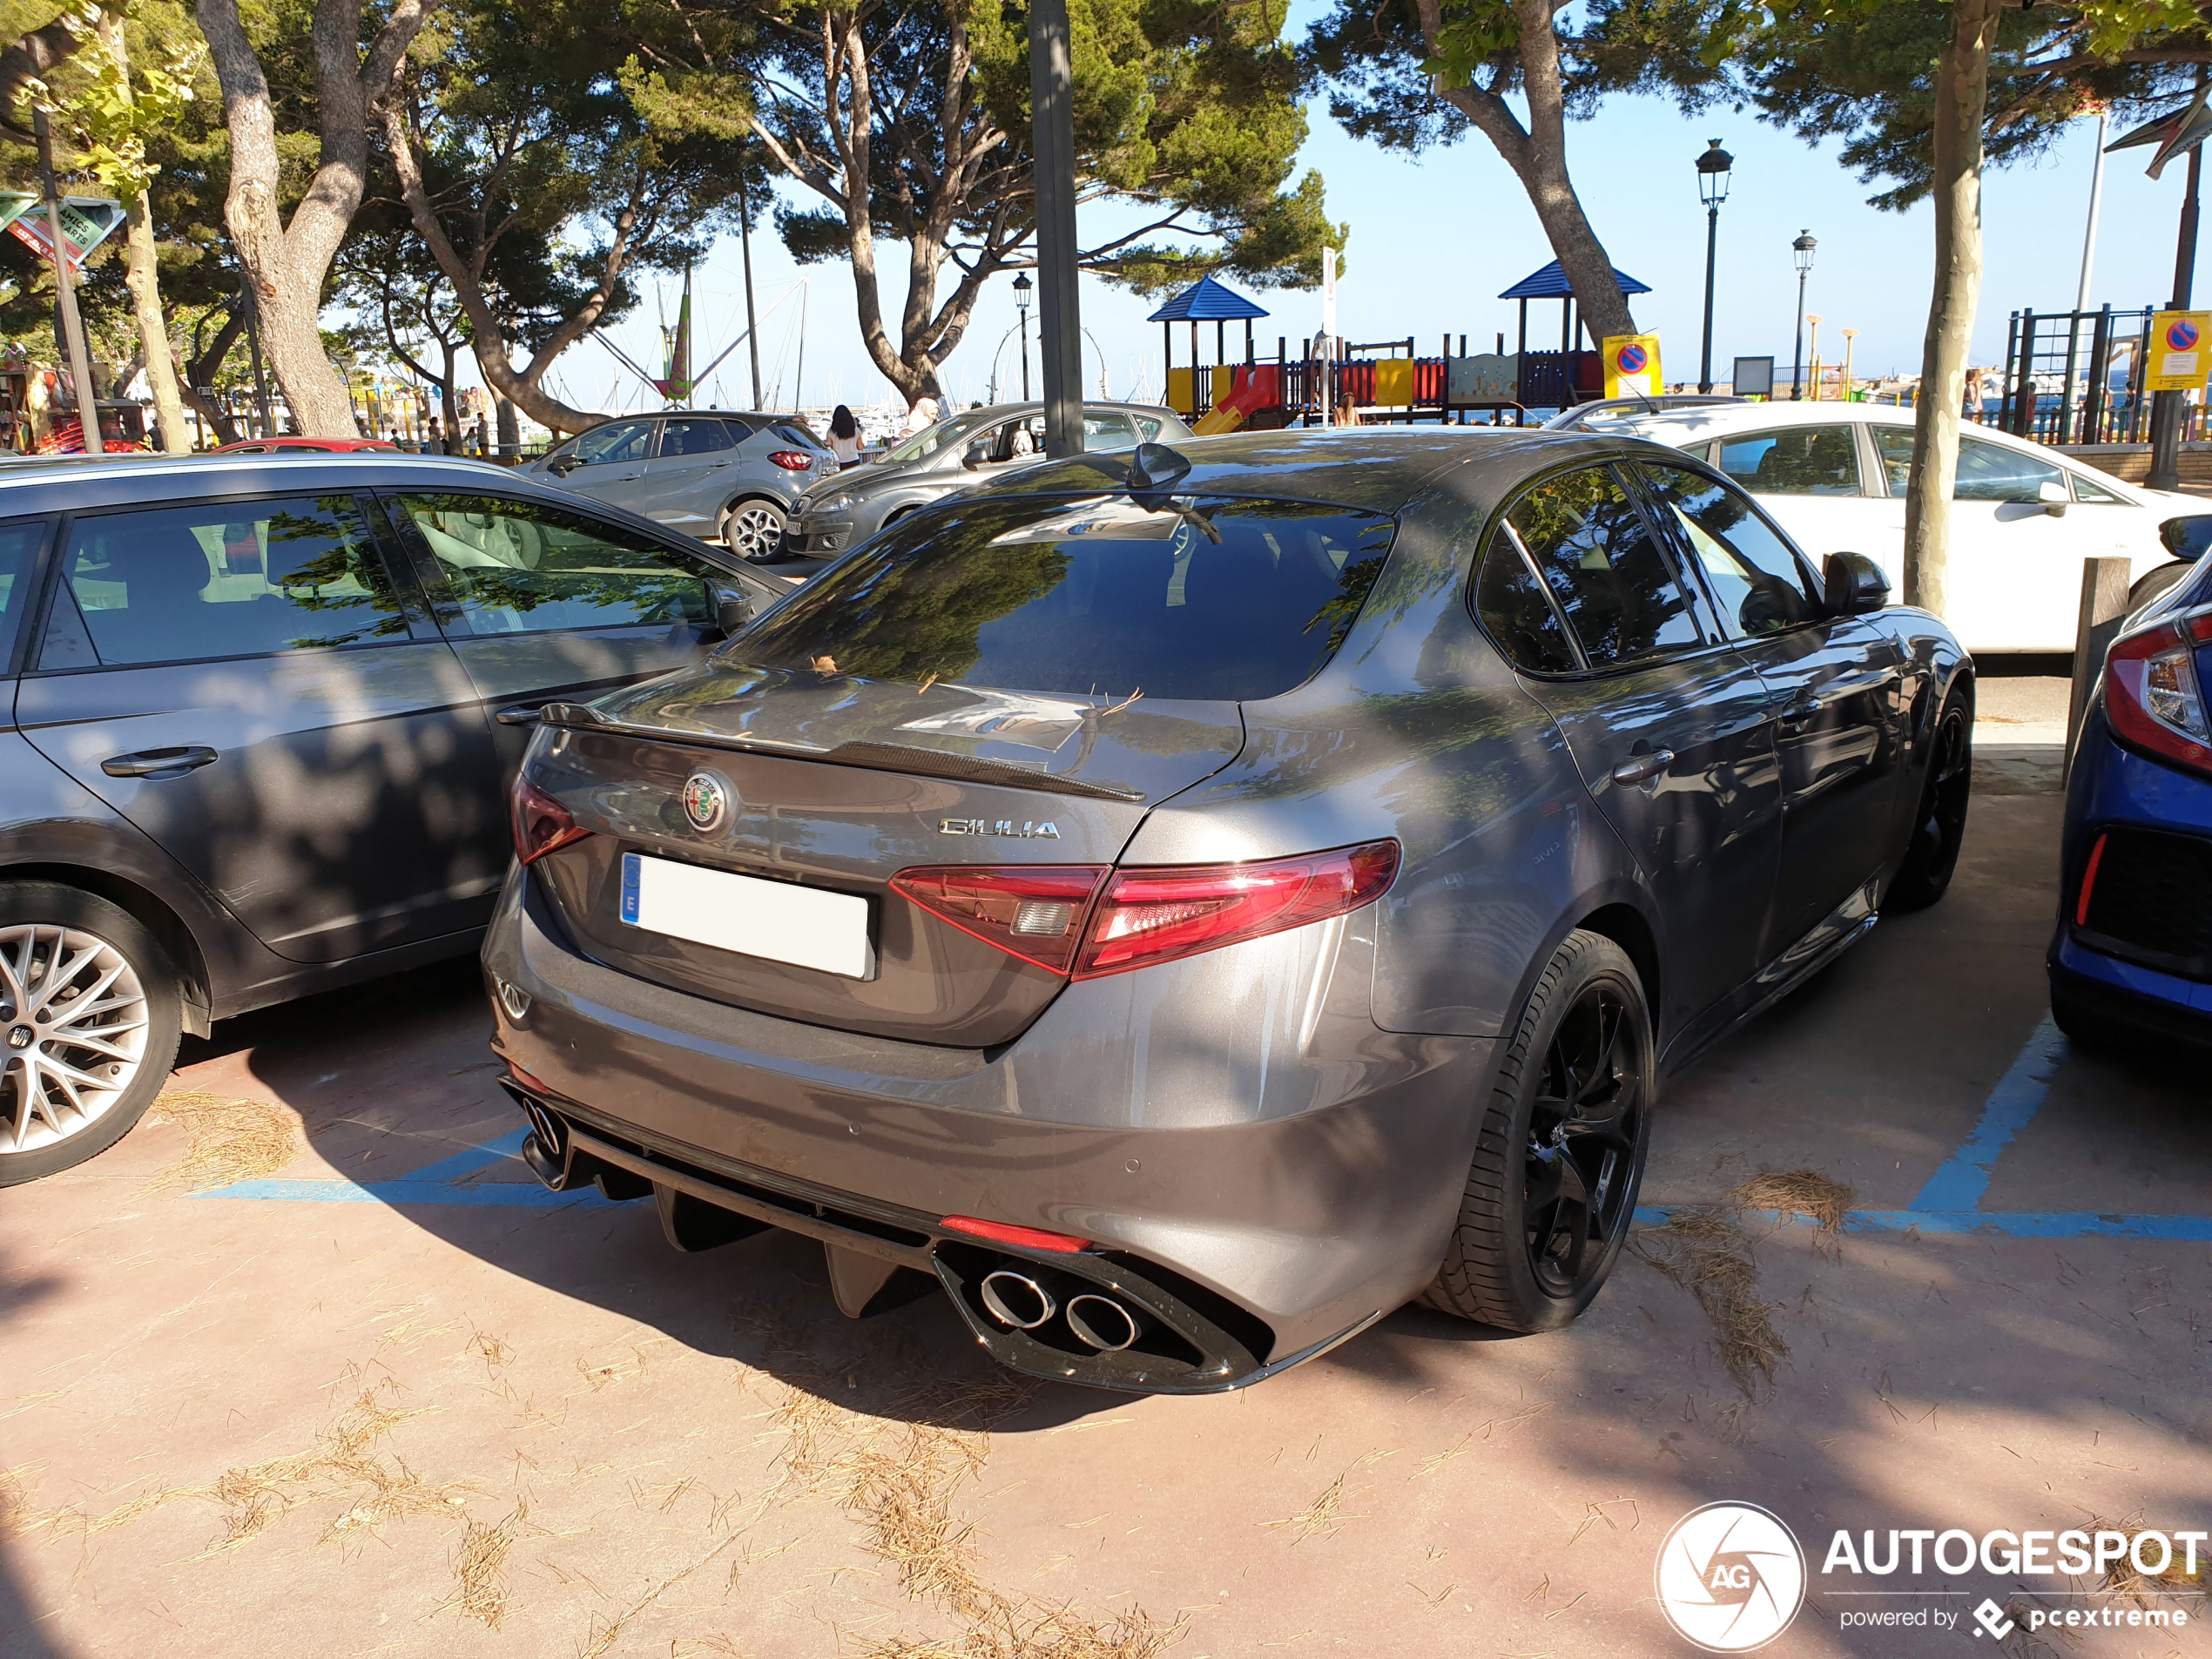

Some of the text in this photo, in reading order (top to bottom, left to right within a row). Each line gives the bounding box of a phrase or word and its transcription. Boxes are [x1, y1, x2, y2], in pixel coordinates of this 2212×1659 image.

[59, 210, 90, 233] AMICS
[64, 226, 88, 245] ARTS
[940, 818, 1060, 839] GIULIA
[627, 896, 635, 911] E
